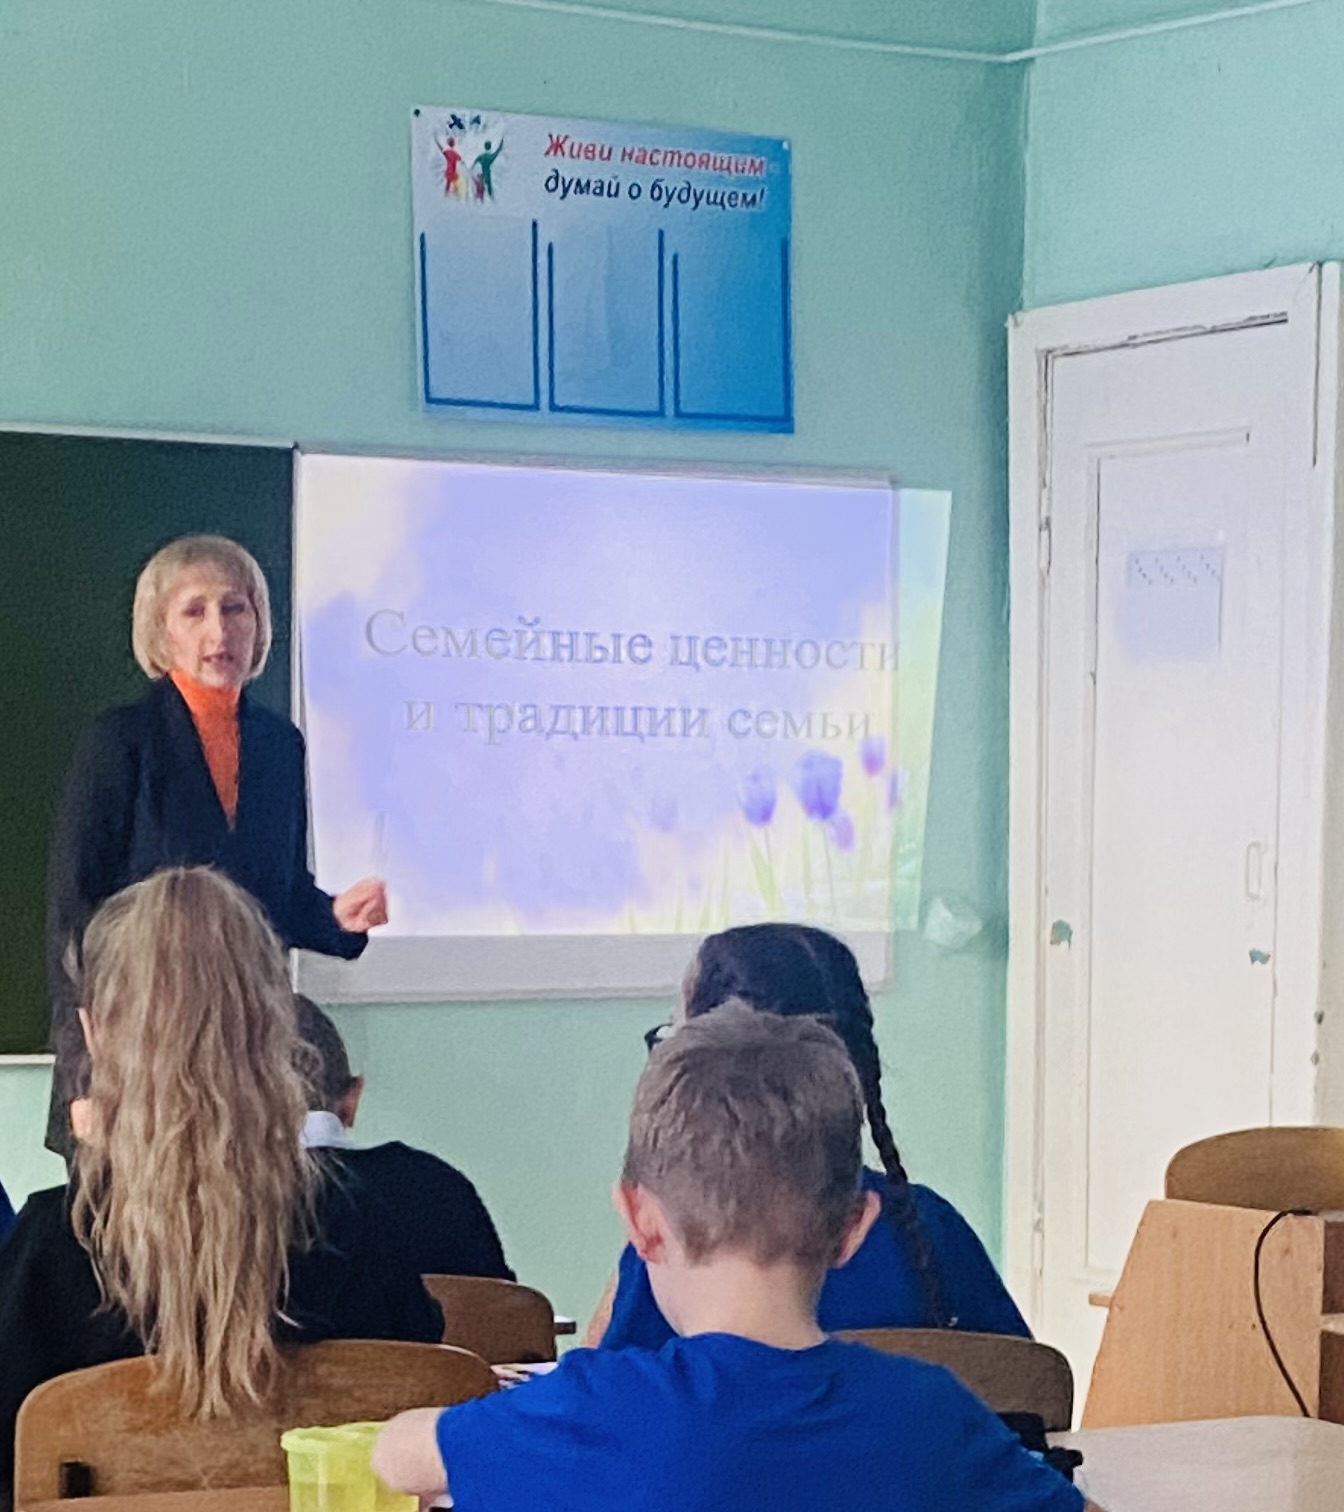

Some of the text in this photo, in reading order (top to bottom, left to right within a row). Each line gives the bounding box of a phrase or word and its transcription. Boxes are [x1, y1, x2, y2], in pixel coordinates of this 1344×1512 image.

[544, 133, 765, 176] Живи настоящим
[544, 168, 766, 211] думай о будущем!
[365, 608, 900, 673] Семейные ценности
[406, 701, 872, 746] и традиции семьи
